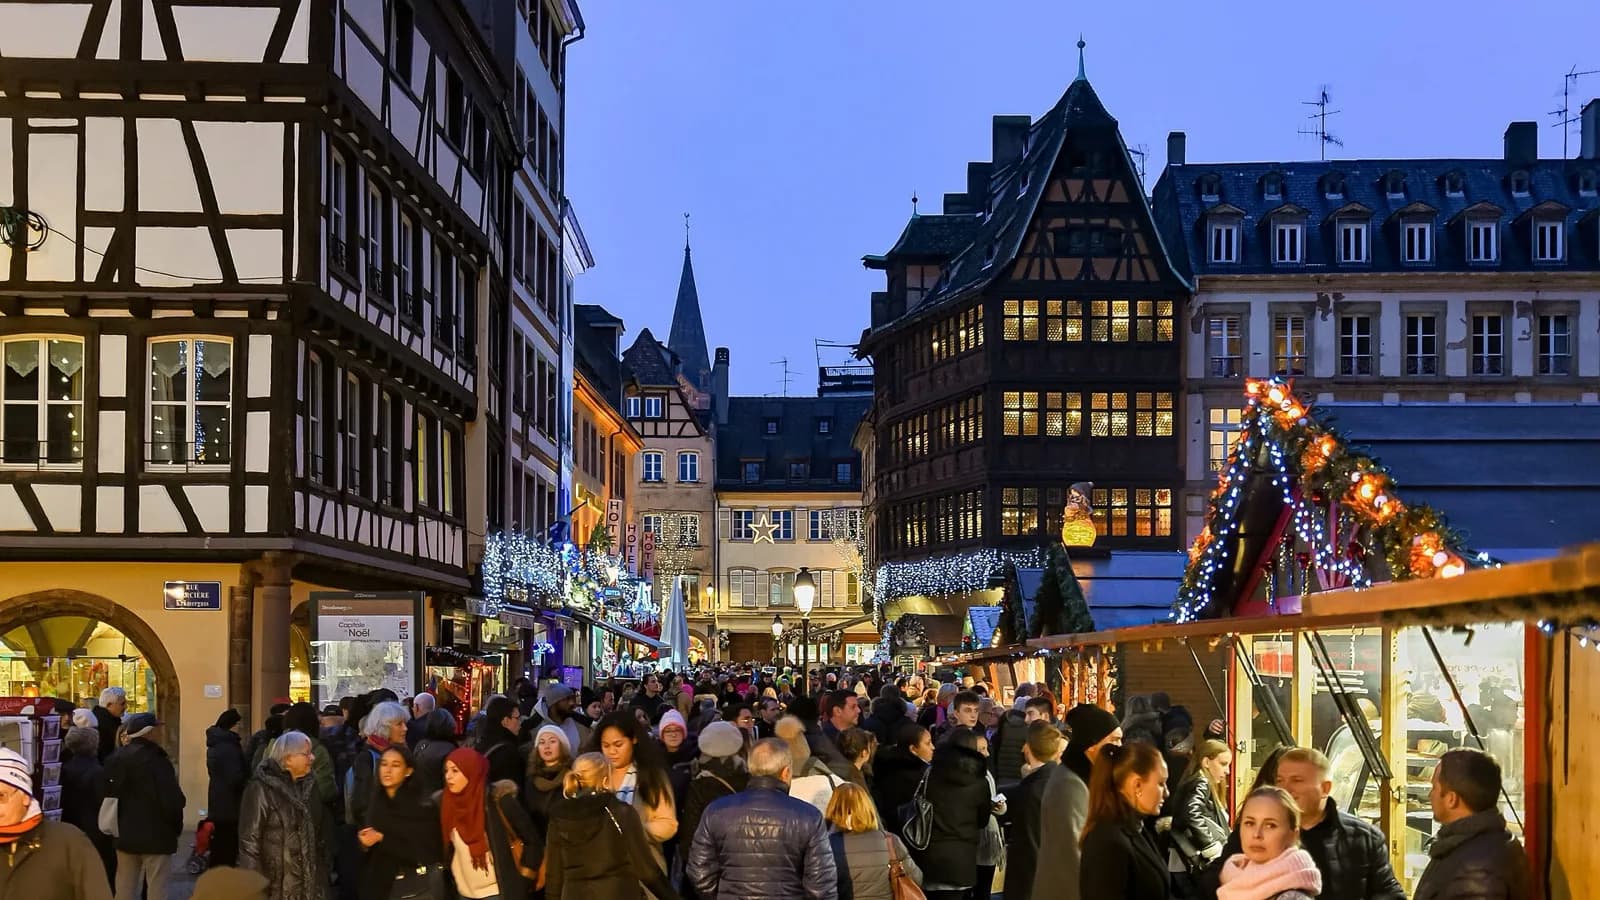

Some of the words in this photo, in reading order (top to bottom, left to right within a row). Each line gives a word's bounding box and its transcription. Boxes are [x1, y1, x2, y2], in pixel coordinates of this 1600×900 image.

[608, 501, 619, 556] HOTEL
[627, 524, 637, 574] HOTEL
[348, 628, 370, 637] Noël
